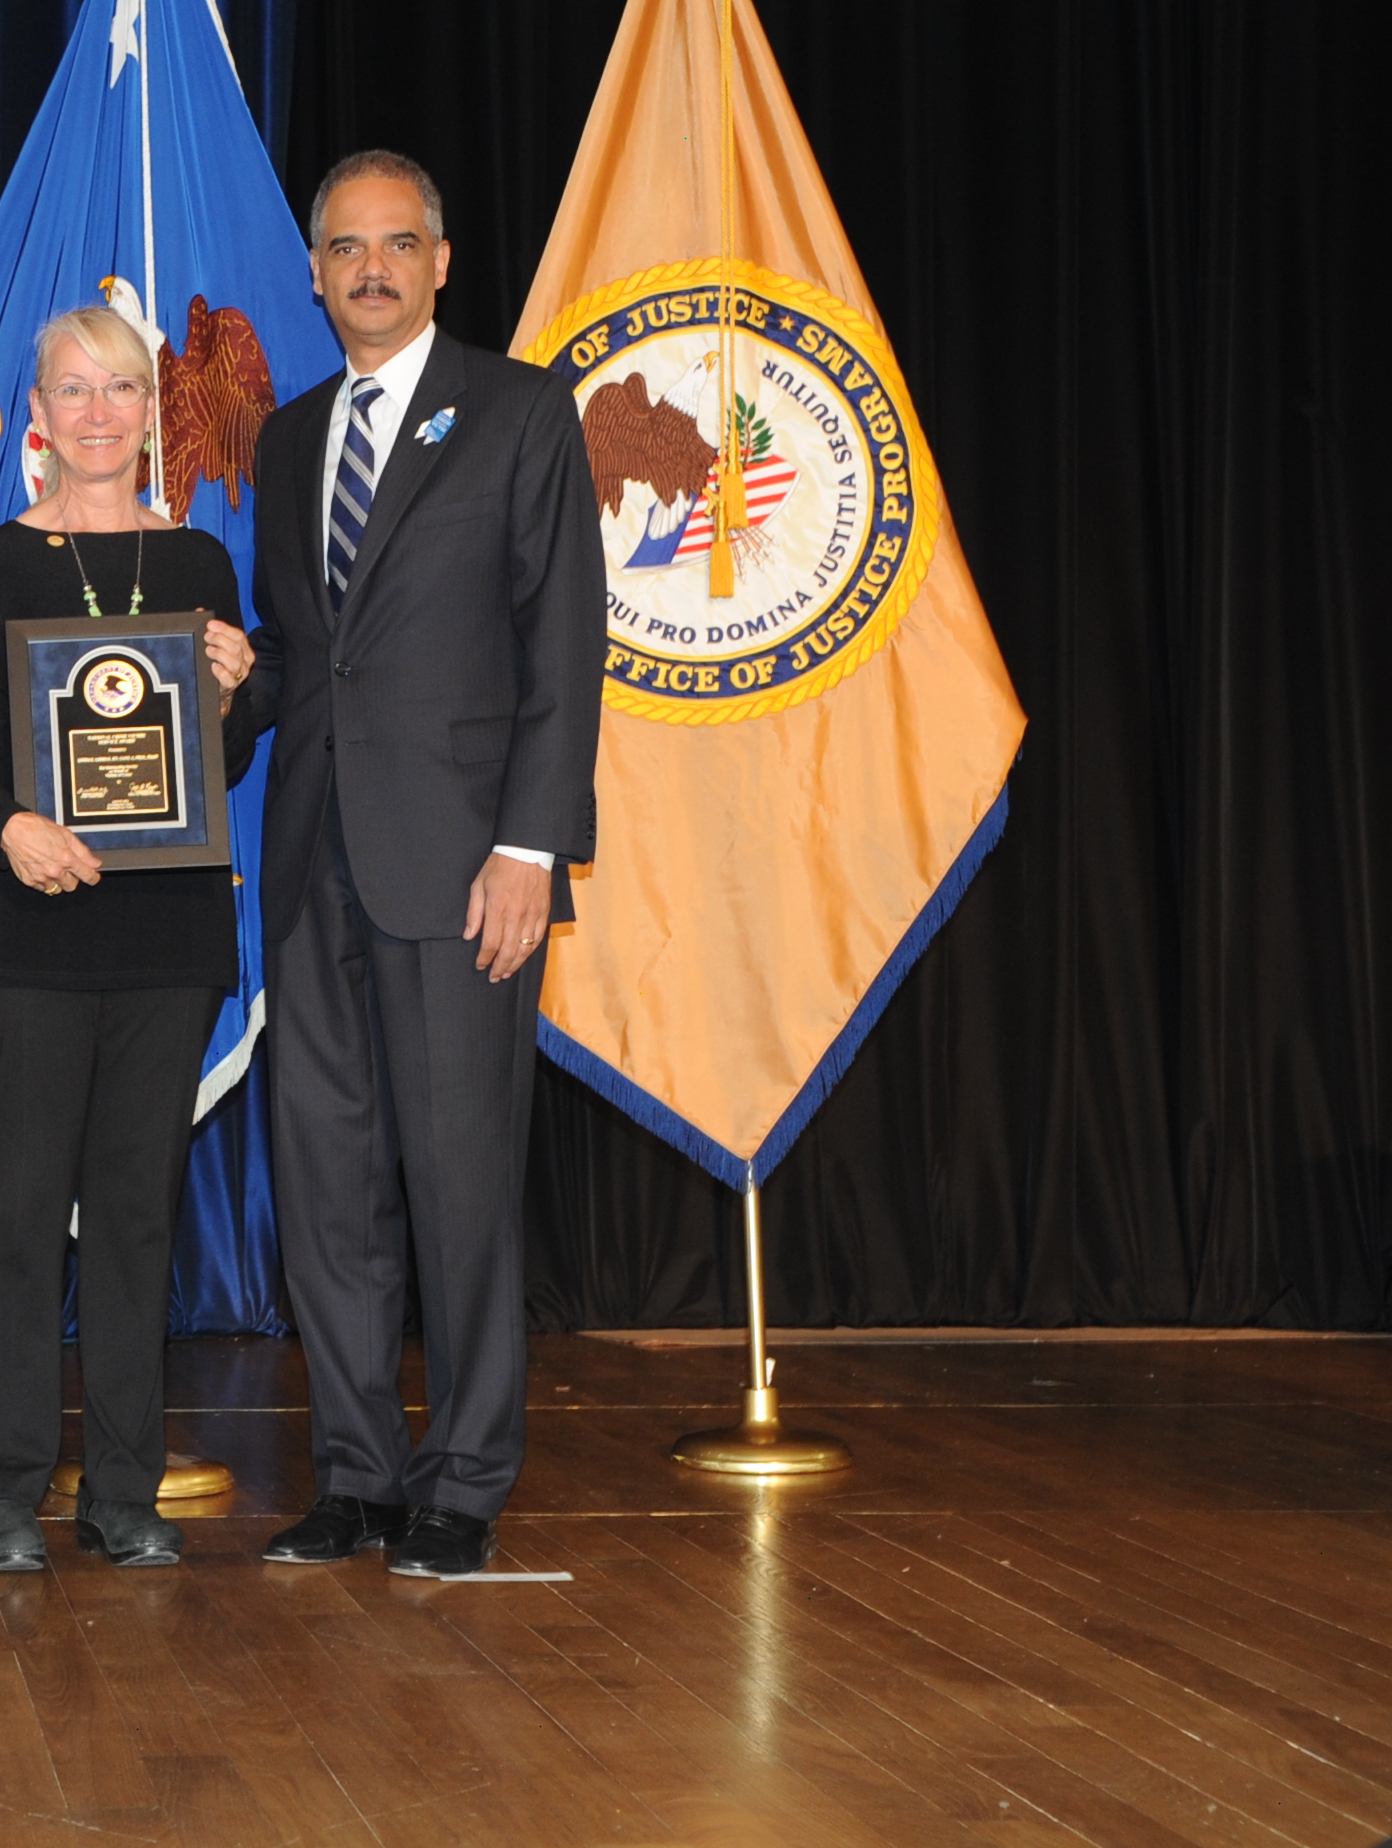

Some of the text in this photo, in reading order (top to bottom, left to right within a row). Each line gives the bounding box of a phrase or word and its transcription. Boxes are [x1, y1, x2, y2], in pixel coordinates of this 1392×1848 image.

[571, 291, 771, 368] OF JUSTICE
[761, 359, 852, 465] SEQUITUR
[604, 324, 908, 692] FFICE OF JUSTICE PROGRAMS
[813, 472, 857, 588] JUSTITIA
[645, 617, 697, 645] PRO
[706, 590, 814, 645] DOMINA
